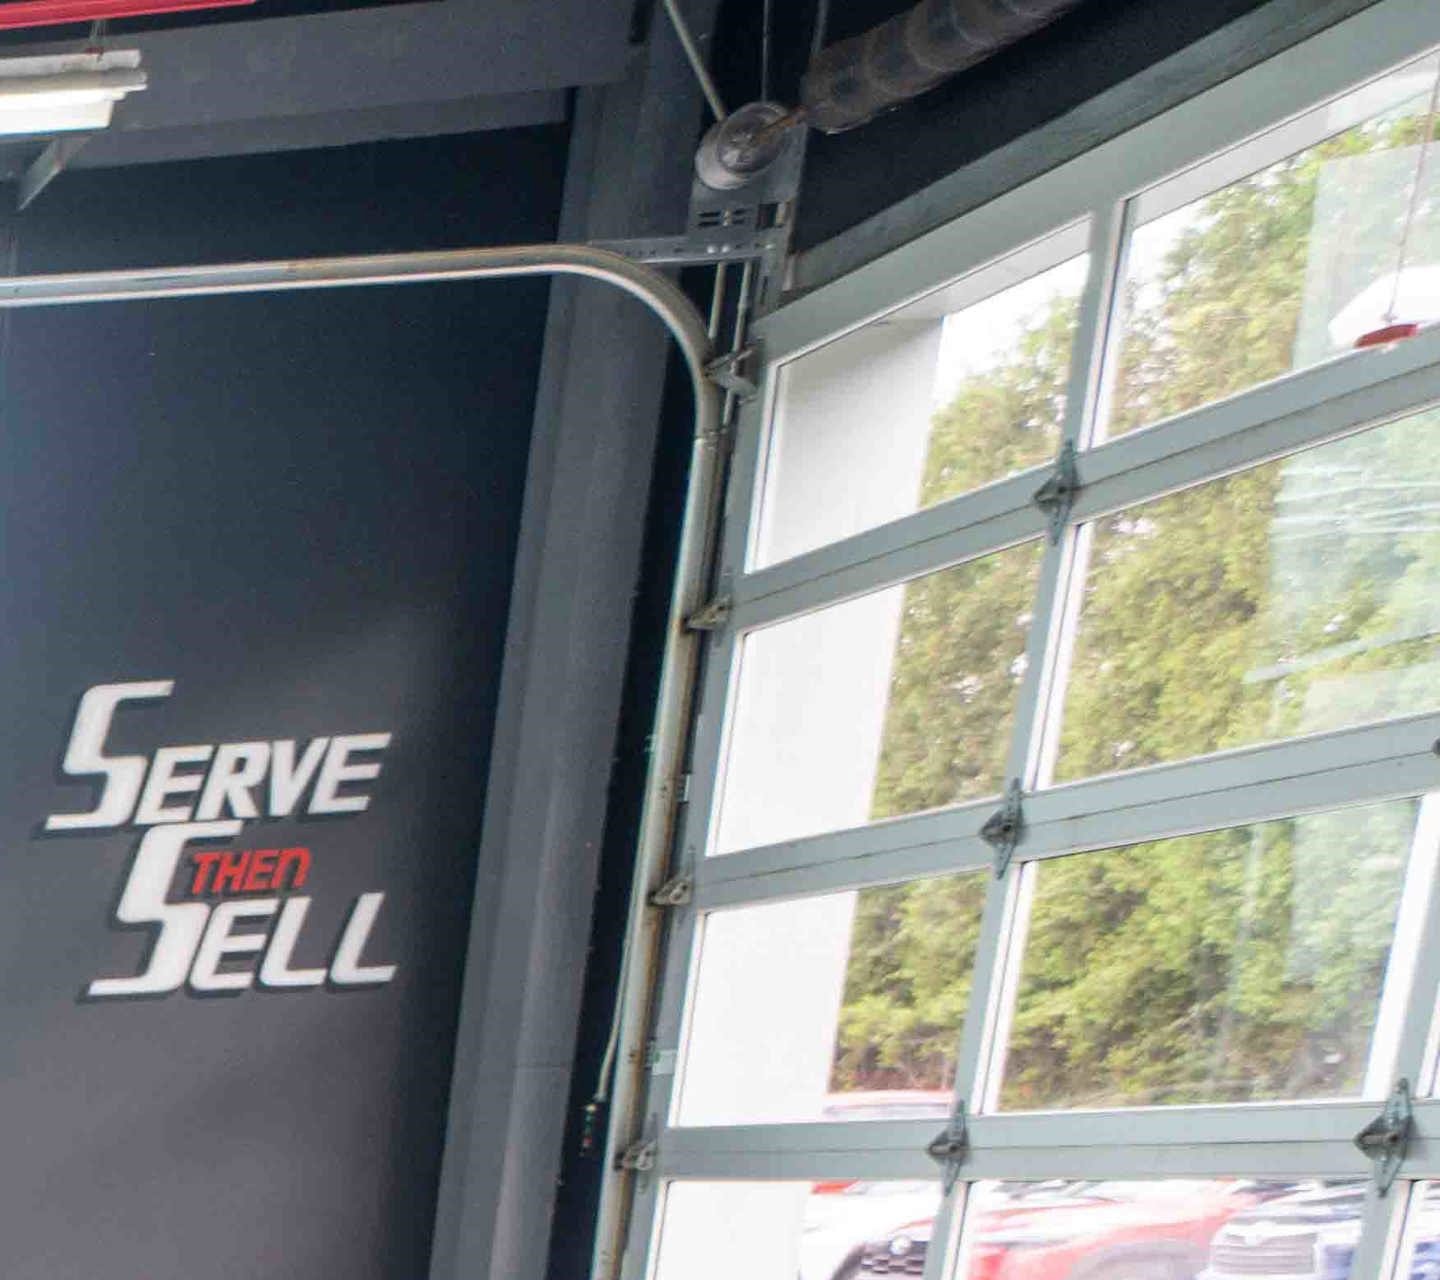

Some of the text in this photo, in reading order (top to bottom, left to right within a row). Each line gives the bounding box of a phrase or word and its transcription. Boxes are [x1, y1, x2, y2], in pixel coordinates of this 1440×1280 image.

[44, 680, 392, 830] SERVE
[88, 819, 398, 996] SELL
[191, 846, 311, 895] THEN
